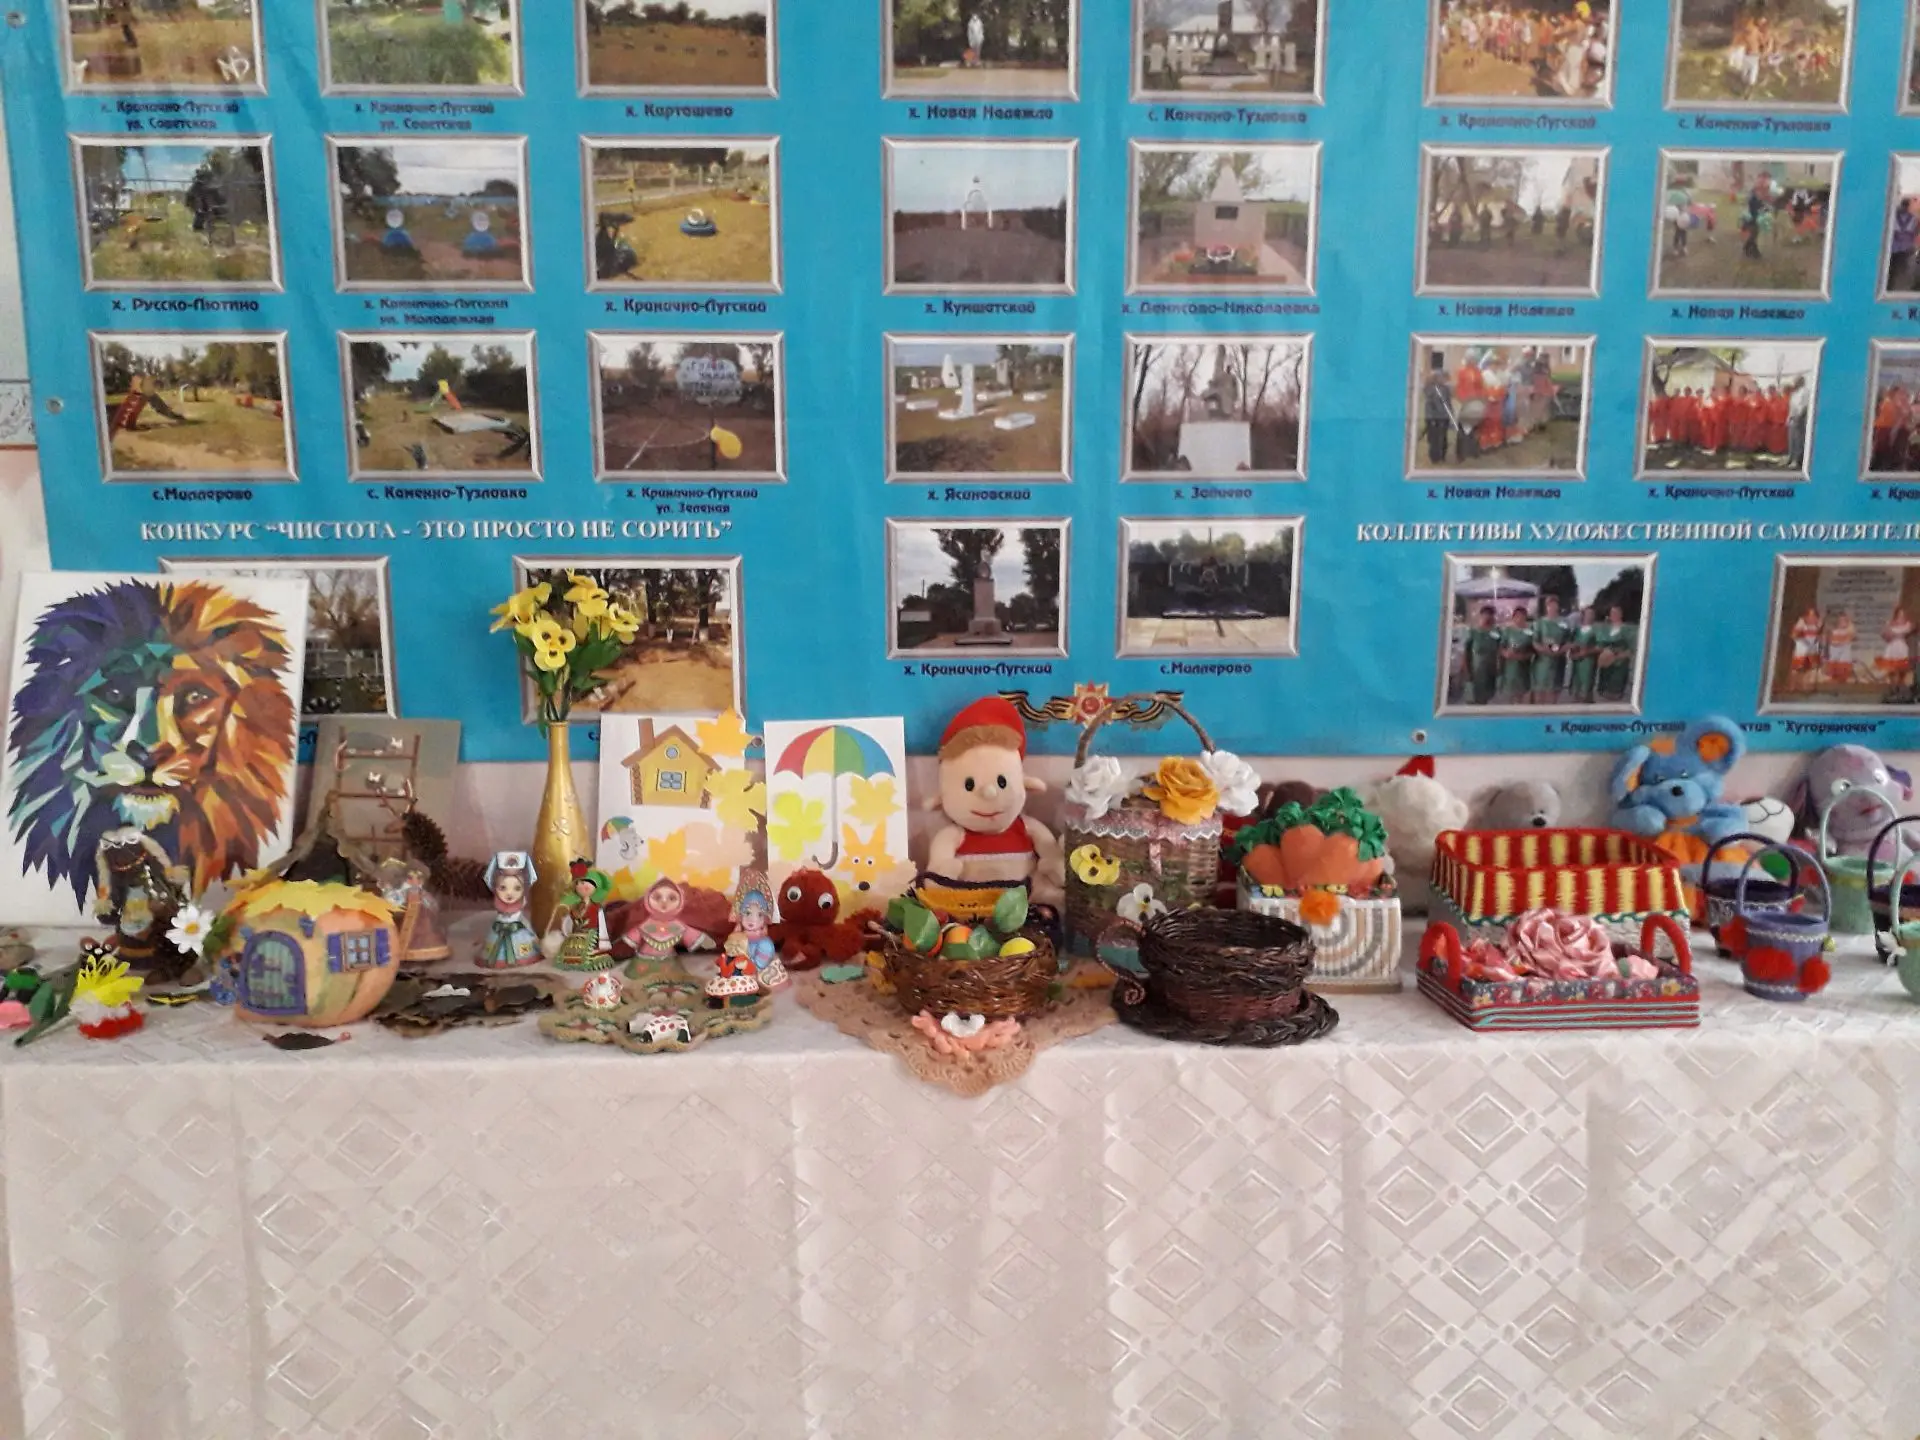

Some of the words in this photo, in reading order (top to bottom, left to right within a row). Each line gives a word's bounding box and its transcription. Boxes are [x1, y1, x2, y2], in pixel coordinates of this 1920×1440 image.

[927, 105, 976, 118] Новая
[983, 105, 1053, 119] Надежда
[132, 298, 259, 312] Русско-Лютино
[624, 299, 766, 316] Кринично-Лугский
[1456, 303, 1502, 317] Новая
[1508, 303, 1575, 318] Надежда
[1688, 305, 1734, 319] Новая
[1739, 306, 1805, 320] Надежда
[384, 487, 527, 503] Каменно-Тузловка
[642, 488, 758, 502] Кринично-Лугский
[944, 488, 1032, 501] Ясиновский
[1445, 485, 1490, 498] Новая
[1496, 486, 1561, 499] Надежда
[1665, 485, 1795, 502] Кринично-Лугский
[140, 521, 260, 541] КОНКУРС
[417, 521, 465, 539] ЭТО
[472, 520, 575, 539] ПРОСТО
[582, 520, 616, 538] НЕ
[1356, 523, 1521, 542] КОЛЛЕКТИВЫ
[1529, 521, 1752, 542] ХУДОЖЕСТВЕННОЙ
[921, 663, 1052, 677] Кринично-Лугский
[1561, 720, 1686, 735] Кринично-Лугский
